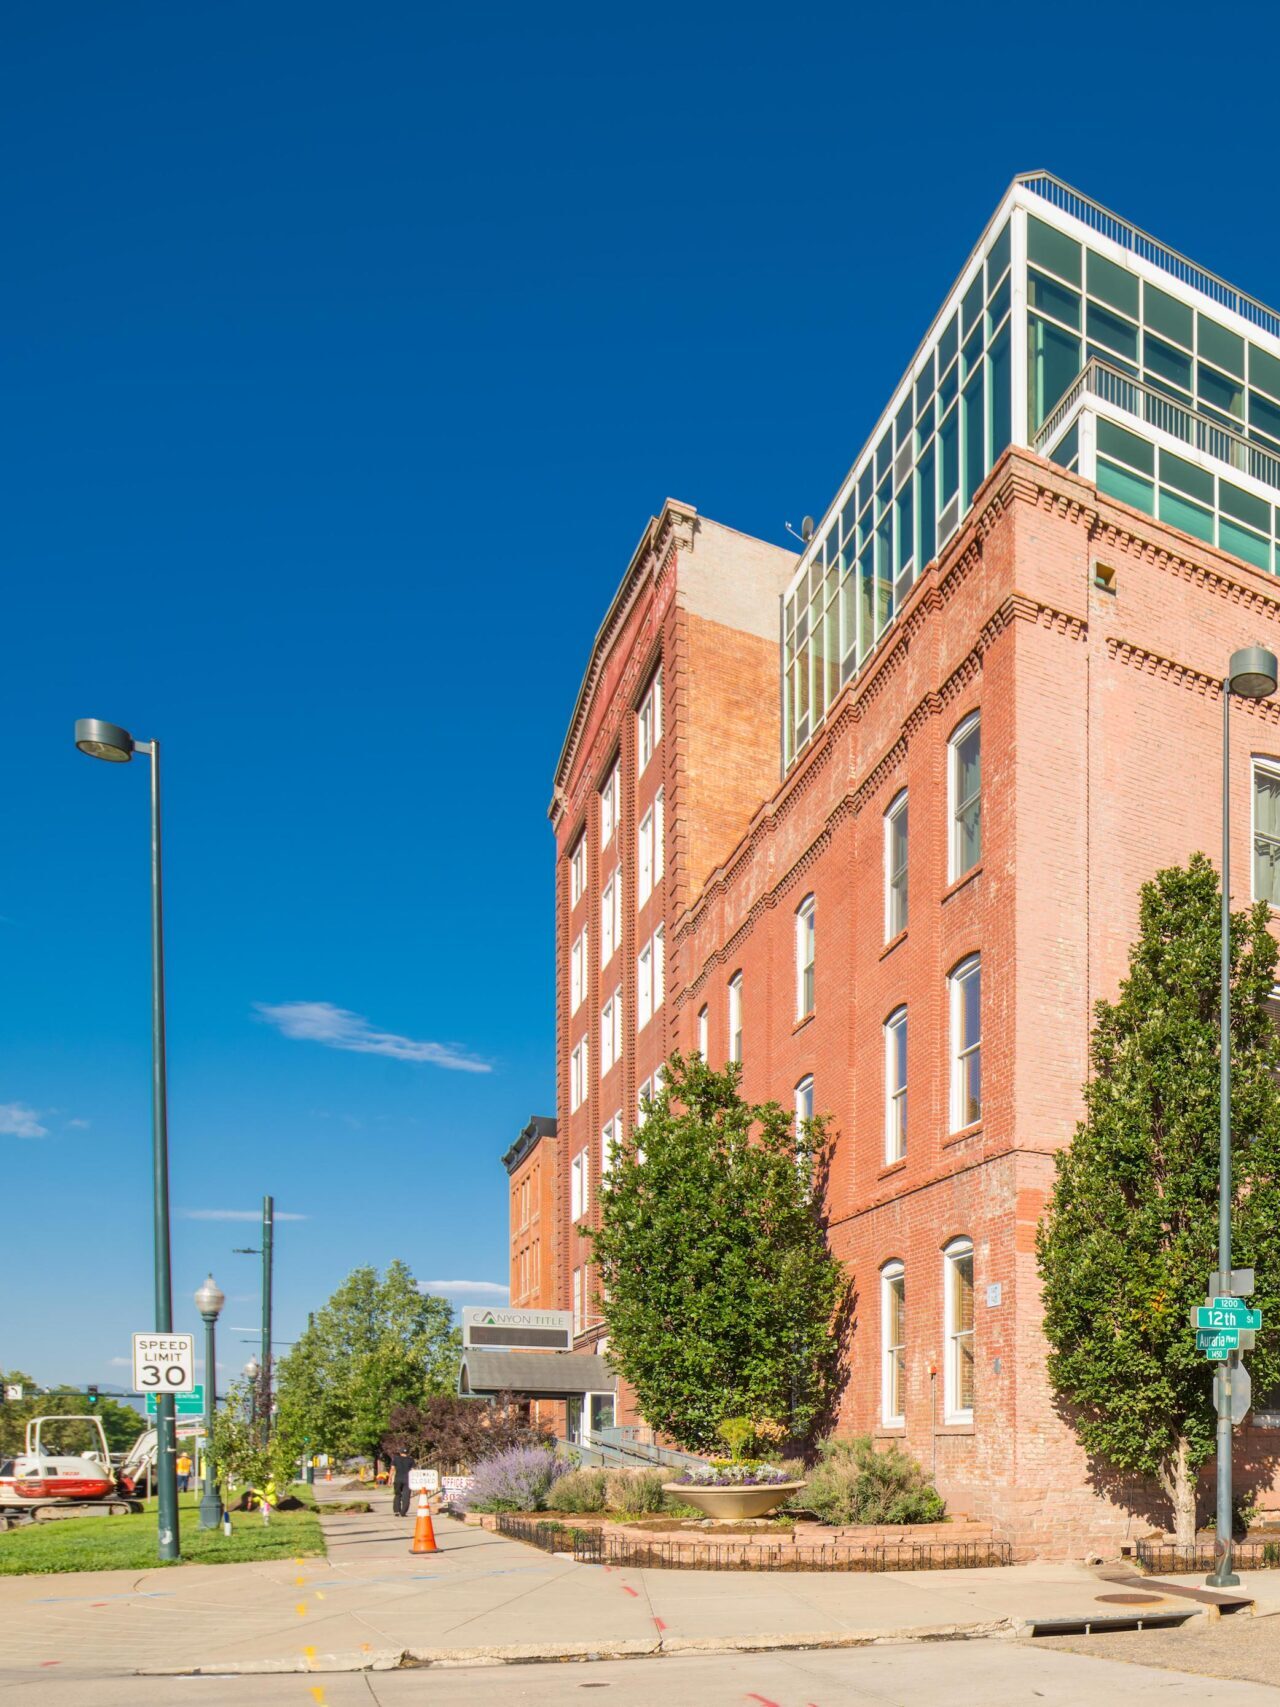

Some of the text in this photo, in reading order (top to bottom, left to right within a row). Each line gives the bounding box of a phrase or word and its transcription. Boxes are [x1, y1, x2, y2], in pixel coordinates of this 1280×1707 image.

[1221, 1299, 1238, 1308] 1200
[472, 1311, 564, 1326] CANYON TITLE
[1208, 1311, 1236, 1326] 12th
[1199, 1332, 1237, 1347] Auraria Pkwy
[139, 1341, 188, 1350] SPEED
[144, 1353, 182, 1362] LIMIT
[1211, 1350, 1223, 1358] 1450
[141, 1365, 186, 1386] 30
[441, 1477, 463, 1488] OFFICE
